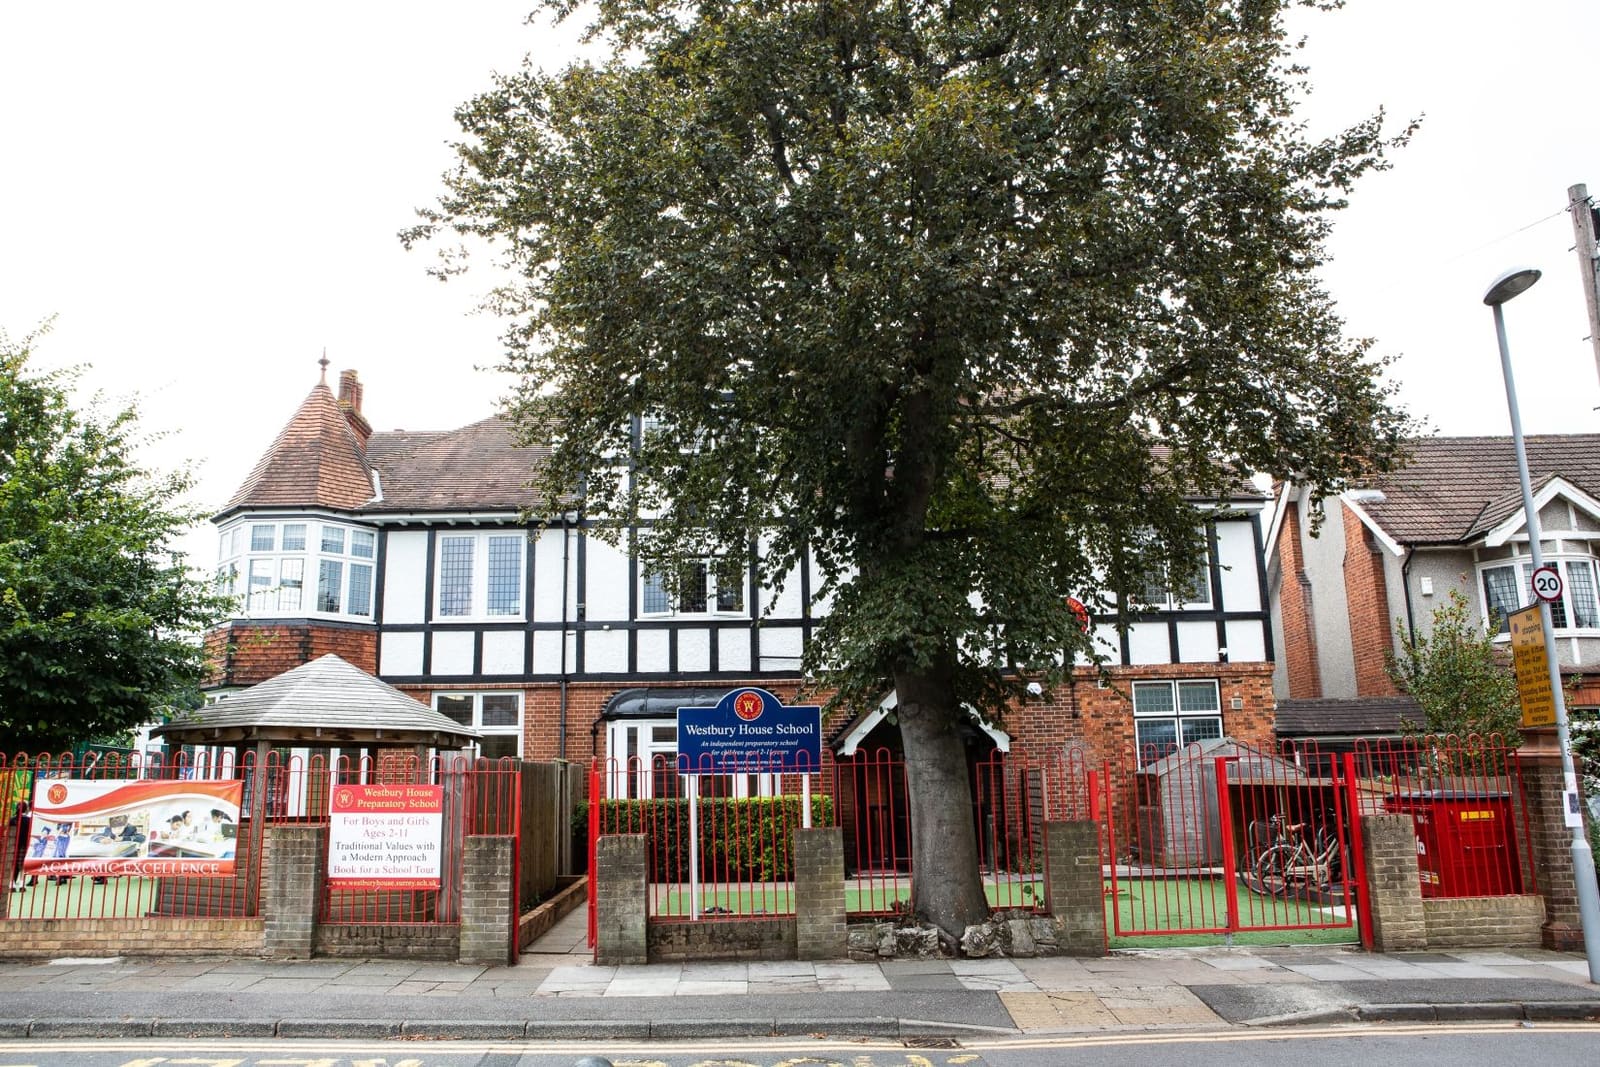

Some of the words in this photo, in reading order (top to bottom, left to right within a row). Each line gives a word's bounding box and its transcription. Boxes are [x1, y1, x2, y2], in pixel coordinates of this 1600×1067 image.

[1537, 577, 1558, 591] 20
[685, 724, 736, 738] Westbury
[739, 724, 773, 735] House
[776, 723, 813, 734] School
[709, 740, 744, 748] independent
[364, 788, 403, 799] Westbury
[407, 788, 433, 797] House
[357, 799, 407, 810] Preparatory
[410, 799, 439, 808] School
[343, 816, 358, 825] For
[362, 816, 385, 828] Boys
[387, 816, 404, 825] and
[407, 816, 430, 825] Girls
[363, 829, 386, 839] Ages
[389, 828, 408, 837] 2-11
[335, 841, 382, 851] Traditional
[385, 841, 413, 851] Values
[416, 841, 435, 850] with
[350, 853, 383, 861] Modern
[385, 853, 427, 863] Approach
[40, 862, 118, 873] ACADEMIC
[123, 862, 220, 874] EXCELLENCE
[333, 865, 356, 874] Book
[359, 865, 371, 874] for
[382, 865, 412, 874] School
[415, 866, 435, 874] Tour
